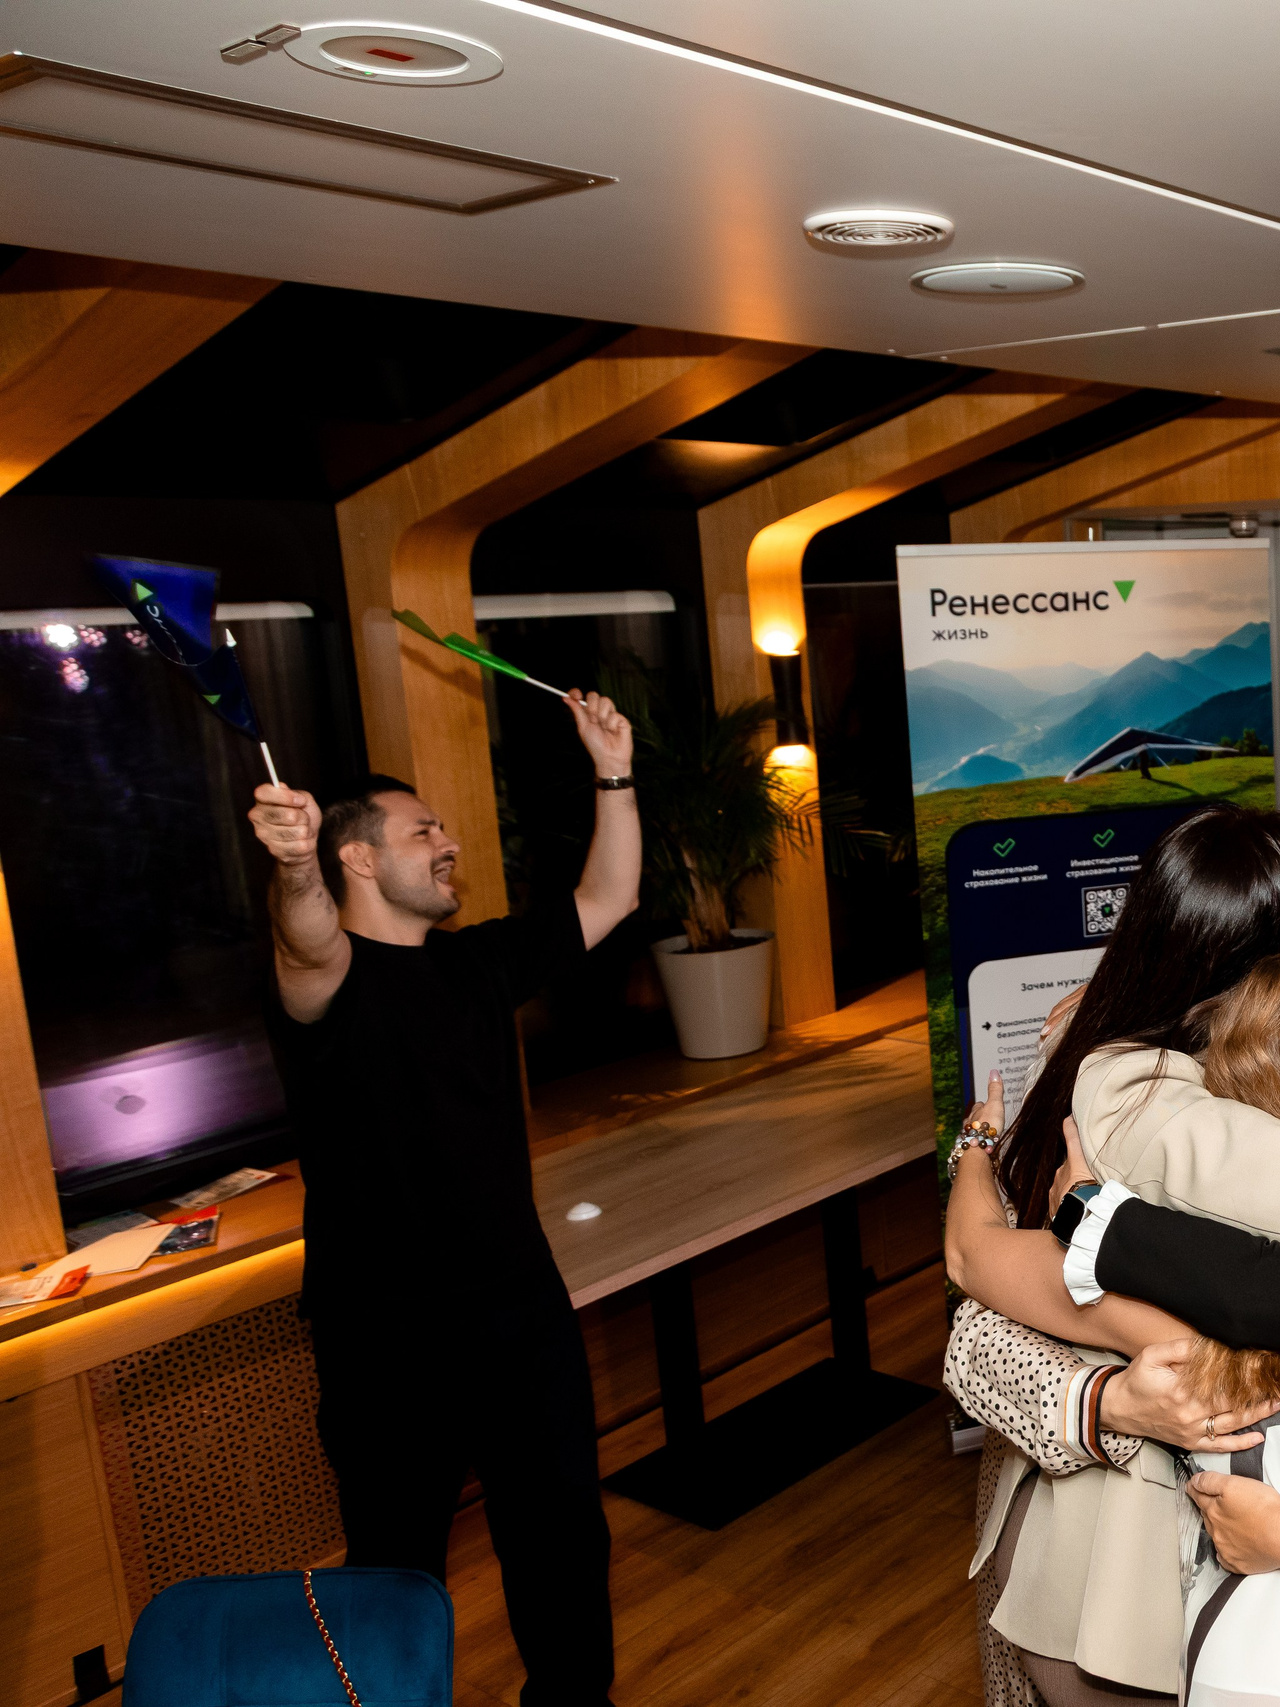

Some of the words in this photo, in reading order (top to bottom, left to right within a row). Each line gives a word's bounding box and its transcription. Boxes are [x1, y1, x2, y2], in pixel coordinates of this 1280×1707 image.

[929, 588, 1109, 617] Ренессанс
[932, 628, 989, 642] жизнь
[972, 864, 1039, 877] Накопительное
[964, 876, 1020, 889] страхование
[1021, 873, 1048, 882] жизни
[1021, 982, 1054, 992] Зачем
